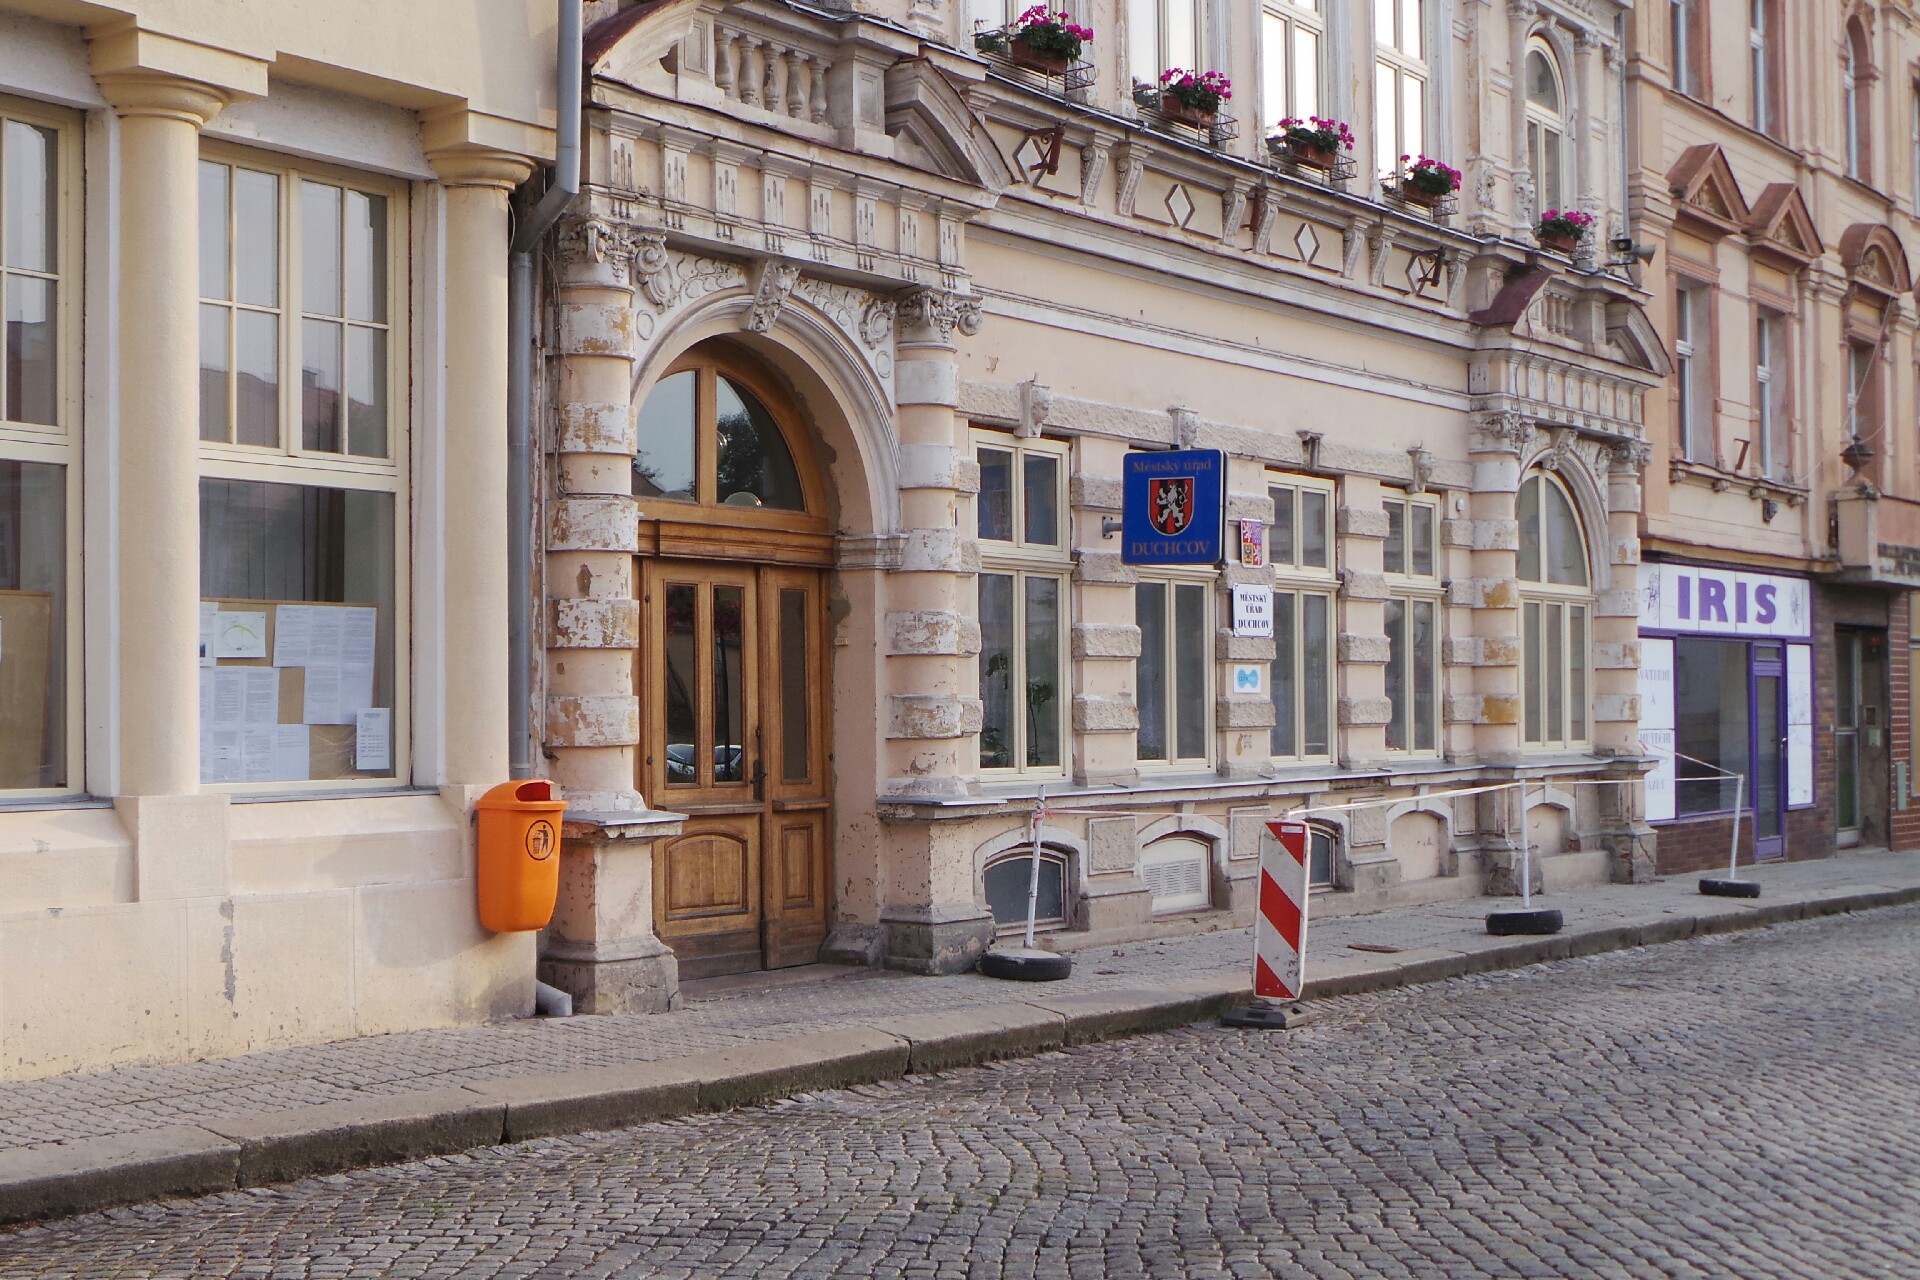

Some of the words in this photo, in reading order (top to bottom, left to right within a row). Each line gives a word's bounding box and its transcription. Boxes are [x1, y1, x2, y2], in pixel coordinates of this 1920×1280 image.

[1132, 541, 1210, 556] DUCHCOV
[1240, 592, 1267, 603] MĚSTSKÝ
[1678, 575, 1777, 624] IRIS
[1246, 603, 1263, 613] ÚŘAD
[1238, 619, 1269, 628] DUCHCOV
